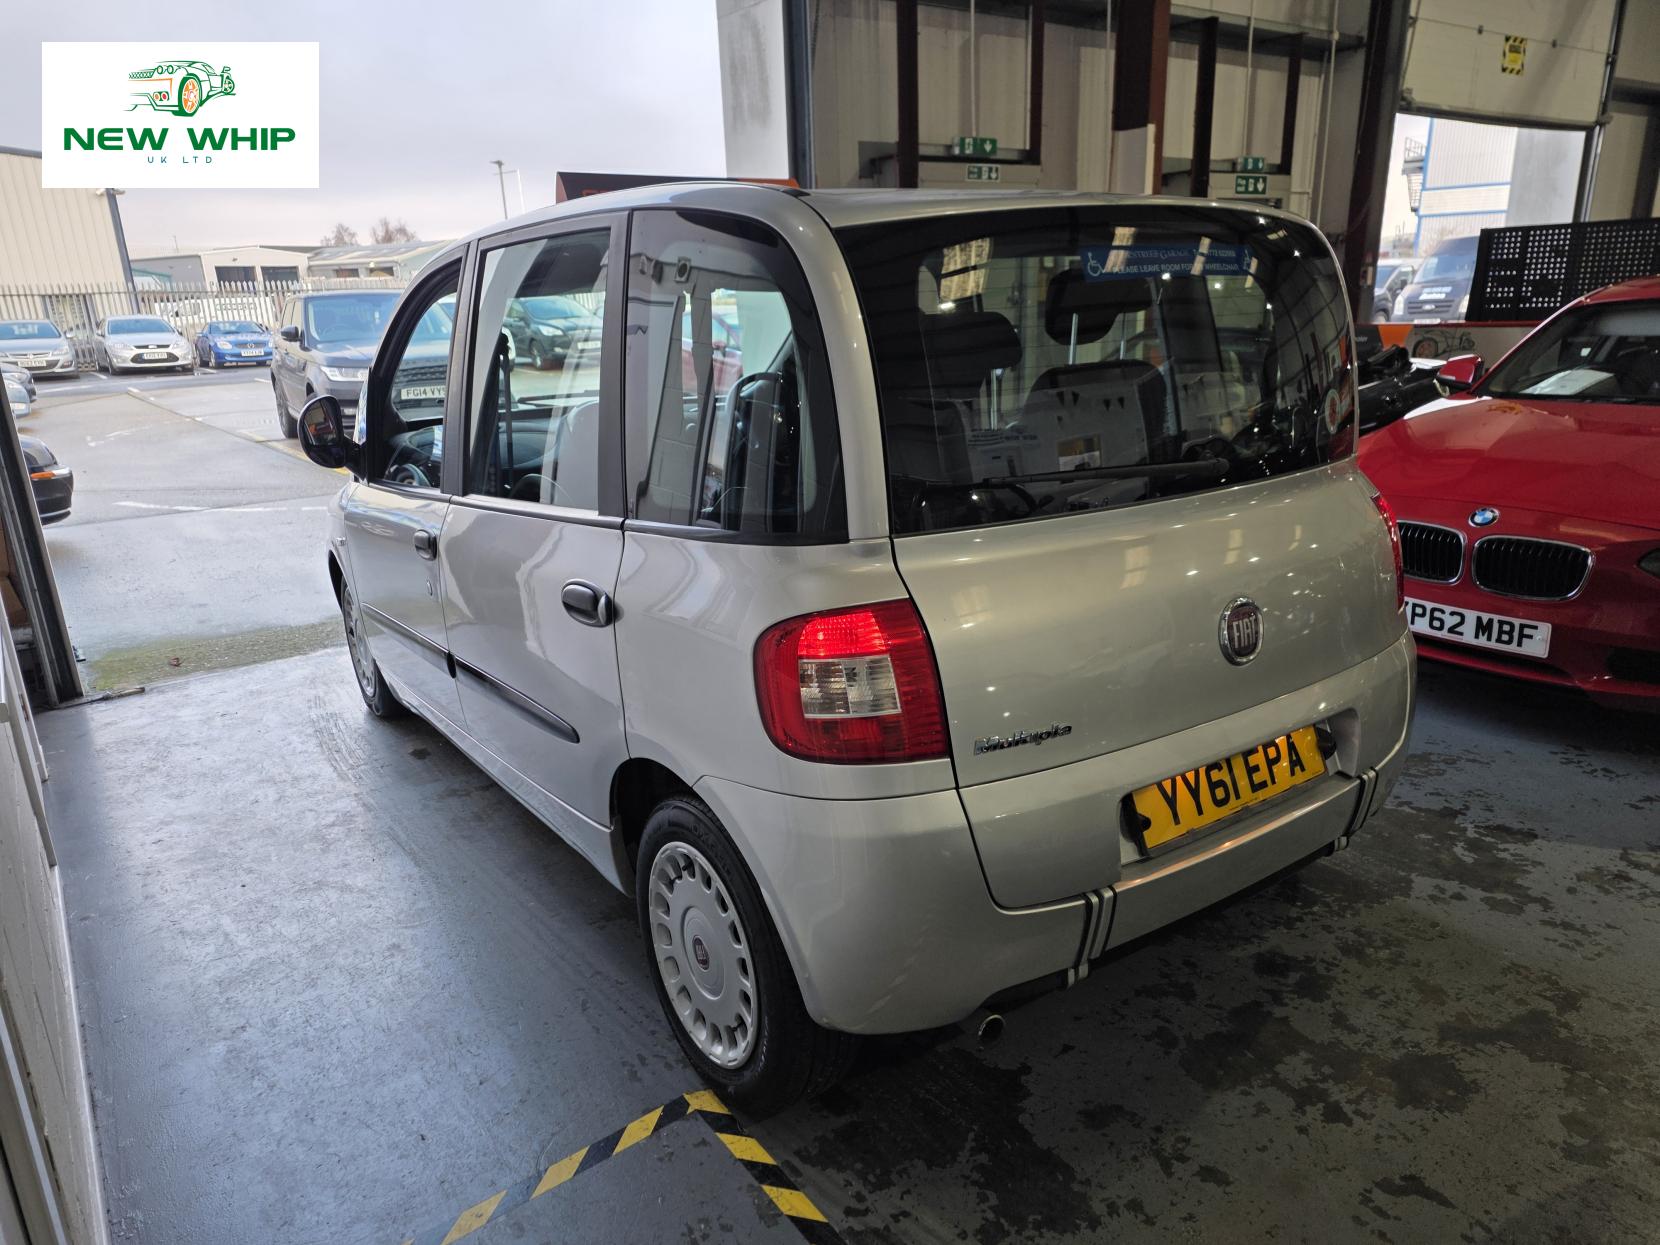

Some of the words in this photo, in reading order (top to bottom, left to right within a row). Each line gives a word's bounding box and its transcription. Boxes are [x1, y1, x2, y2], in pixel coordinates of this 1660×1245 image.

[1139, 264, 1161, 273] LEAVE
[1161, 263, 1181, 272] ROOM
[1233, 614, 1256, 649] FIAT
[1474, 615, 1539, 648] MBF
[974, 724, 1073, 756] Multipla
[1155, 757, 1241, 826] YY61
[1242, 733, 1306, 794] EPA
